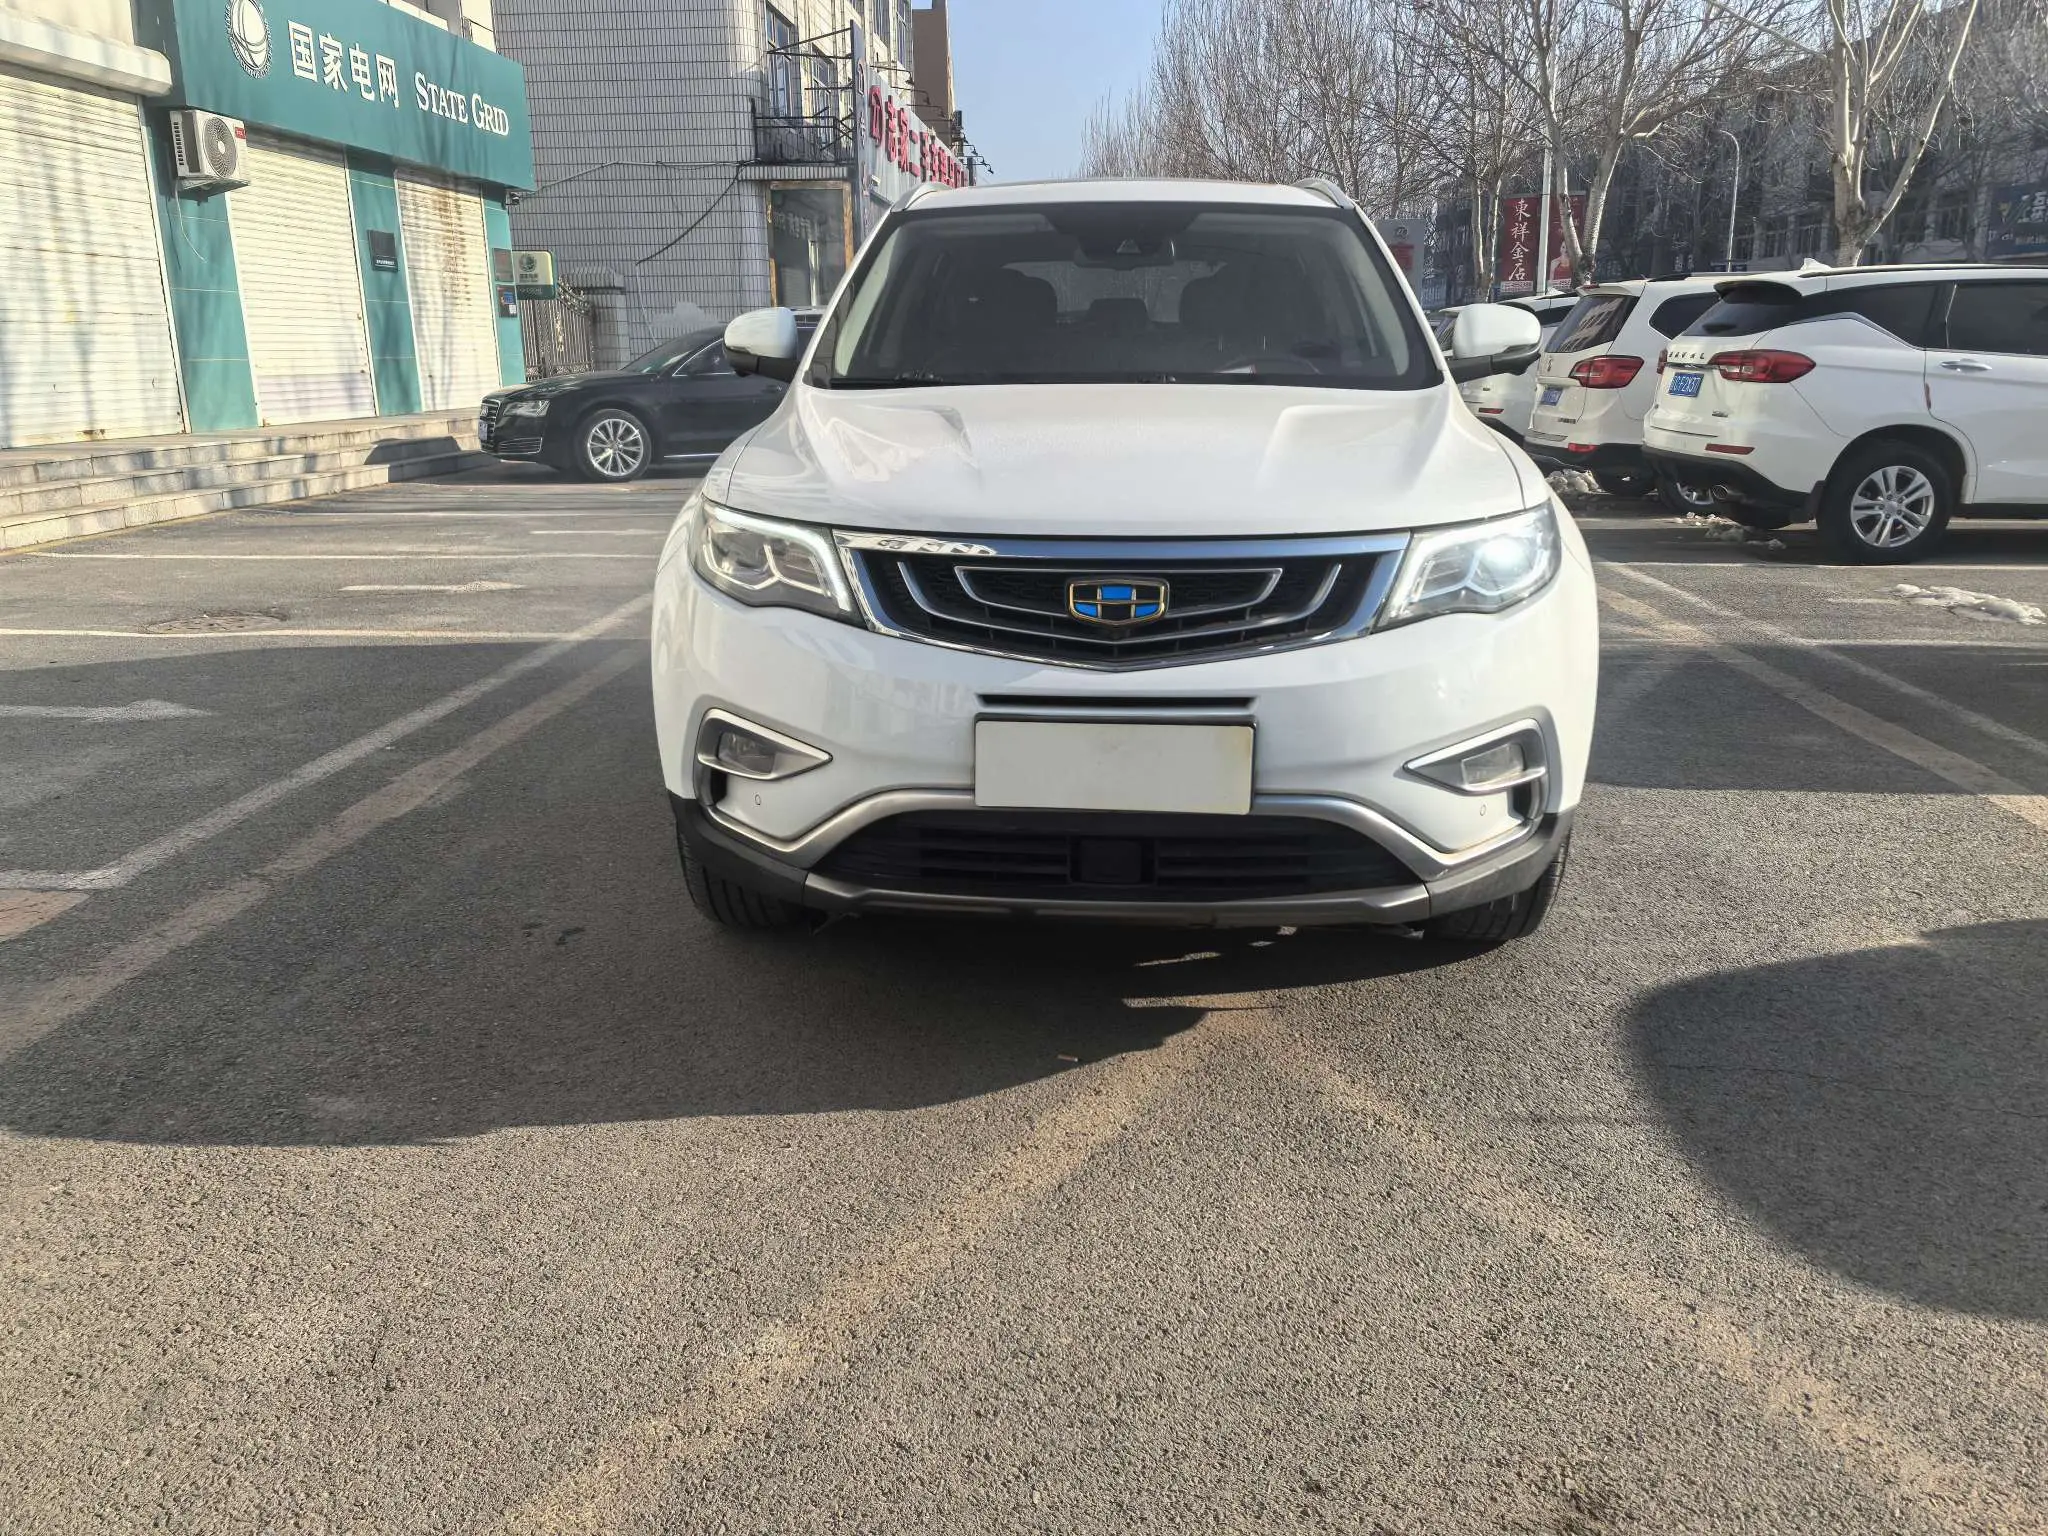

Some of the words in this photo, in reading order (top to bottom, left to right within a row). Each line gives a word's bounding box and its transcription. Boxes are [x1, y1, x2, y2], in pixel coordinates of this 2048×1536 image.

[287, 19, 400, 109] 国家电网
[414, 71, 468, 125] STATE
[471, 92, 510, 137] GRID
[1508, 198, 1531, 281] 東祥金店
